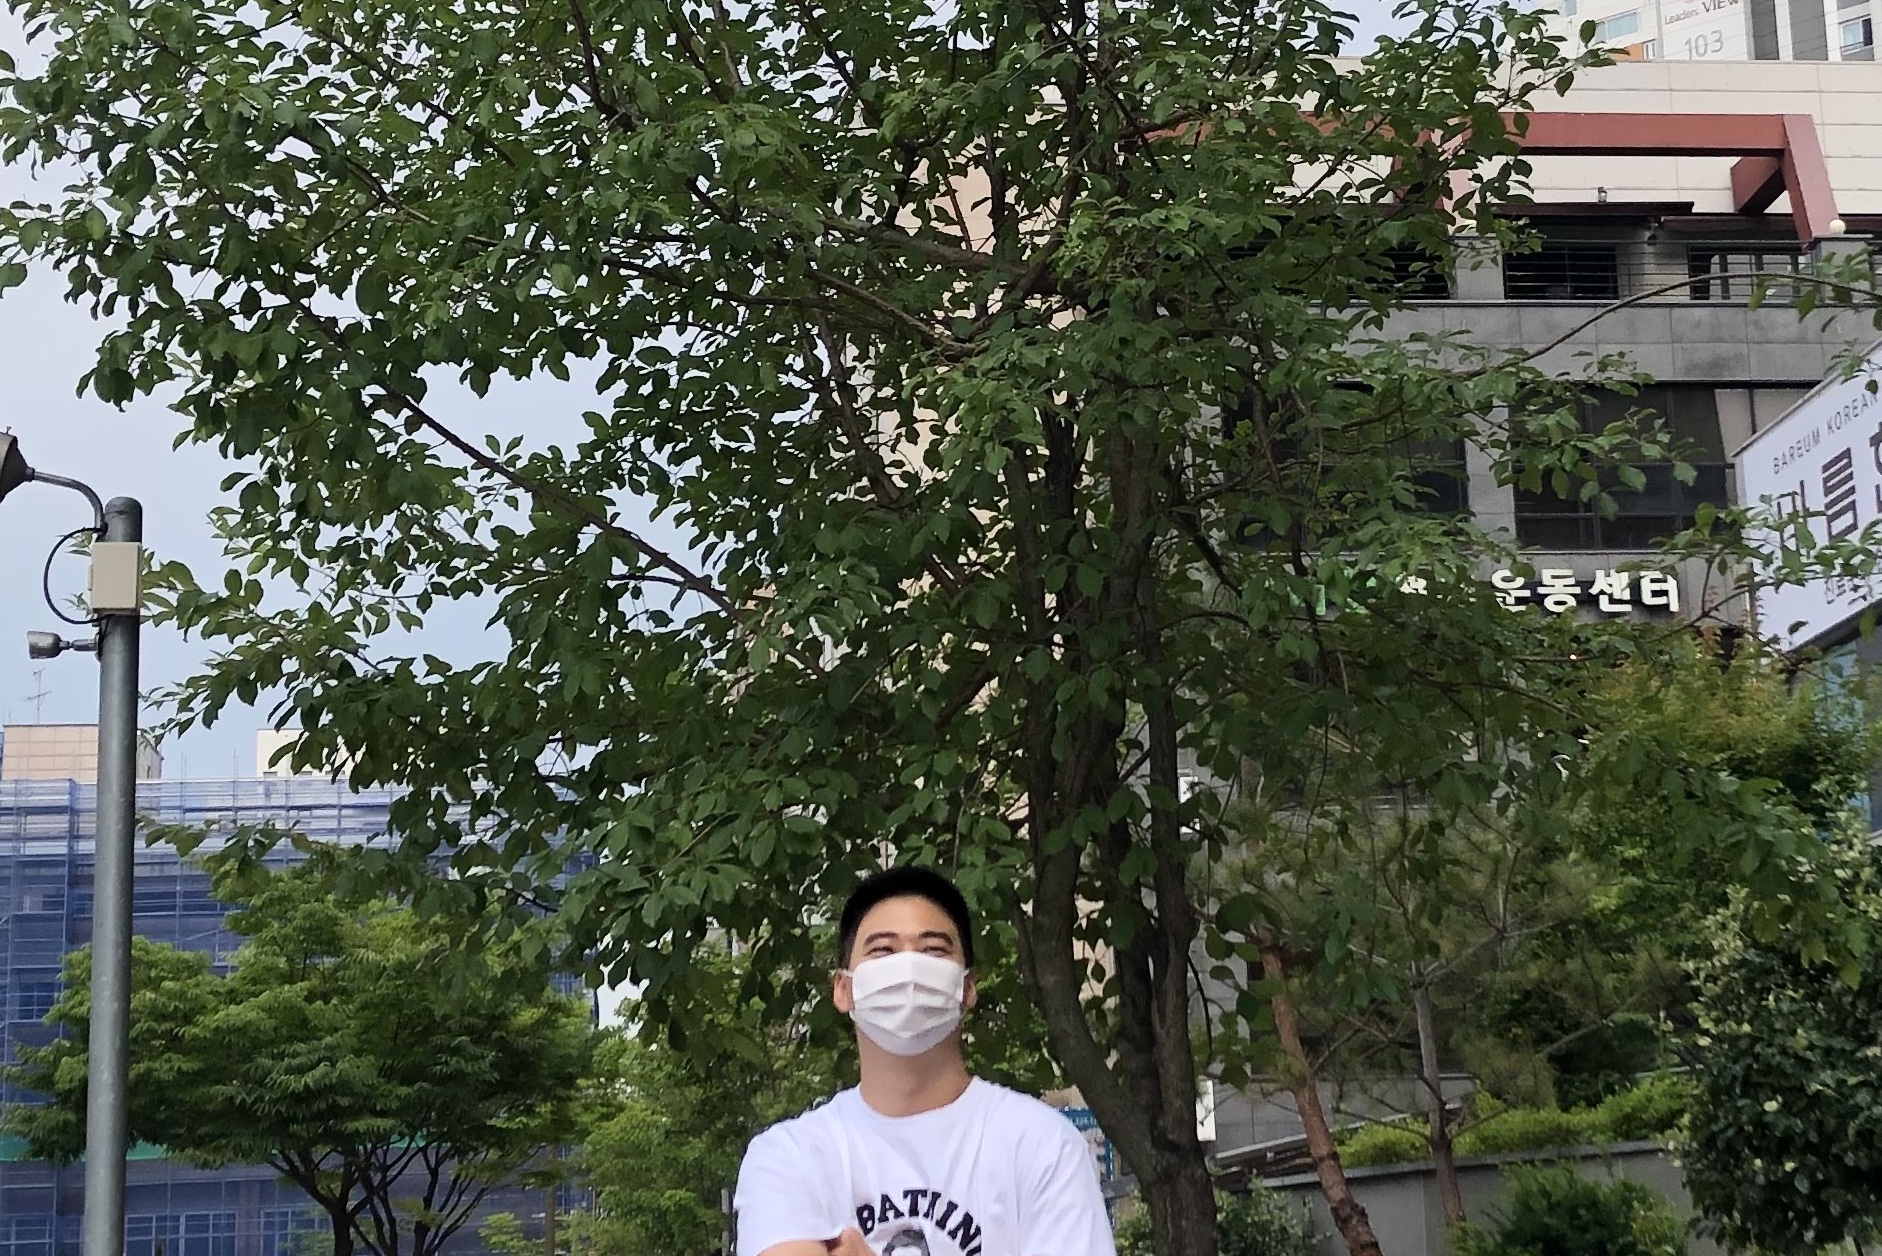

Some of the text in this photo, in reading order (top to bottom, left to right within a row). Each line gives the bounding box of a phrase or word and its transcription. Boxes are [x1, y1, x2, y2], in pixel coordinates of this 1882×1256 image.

[1684, 29, 1724, 60] 103
[1773, 426, 1821, 475] BAREUM
[1491, 567, 1680, 613] 운동센터
